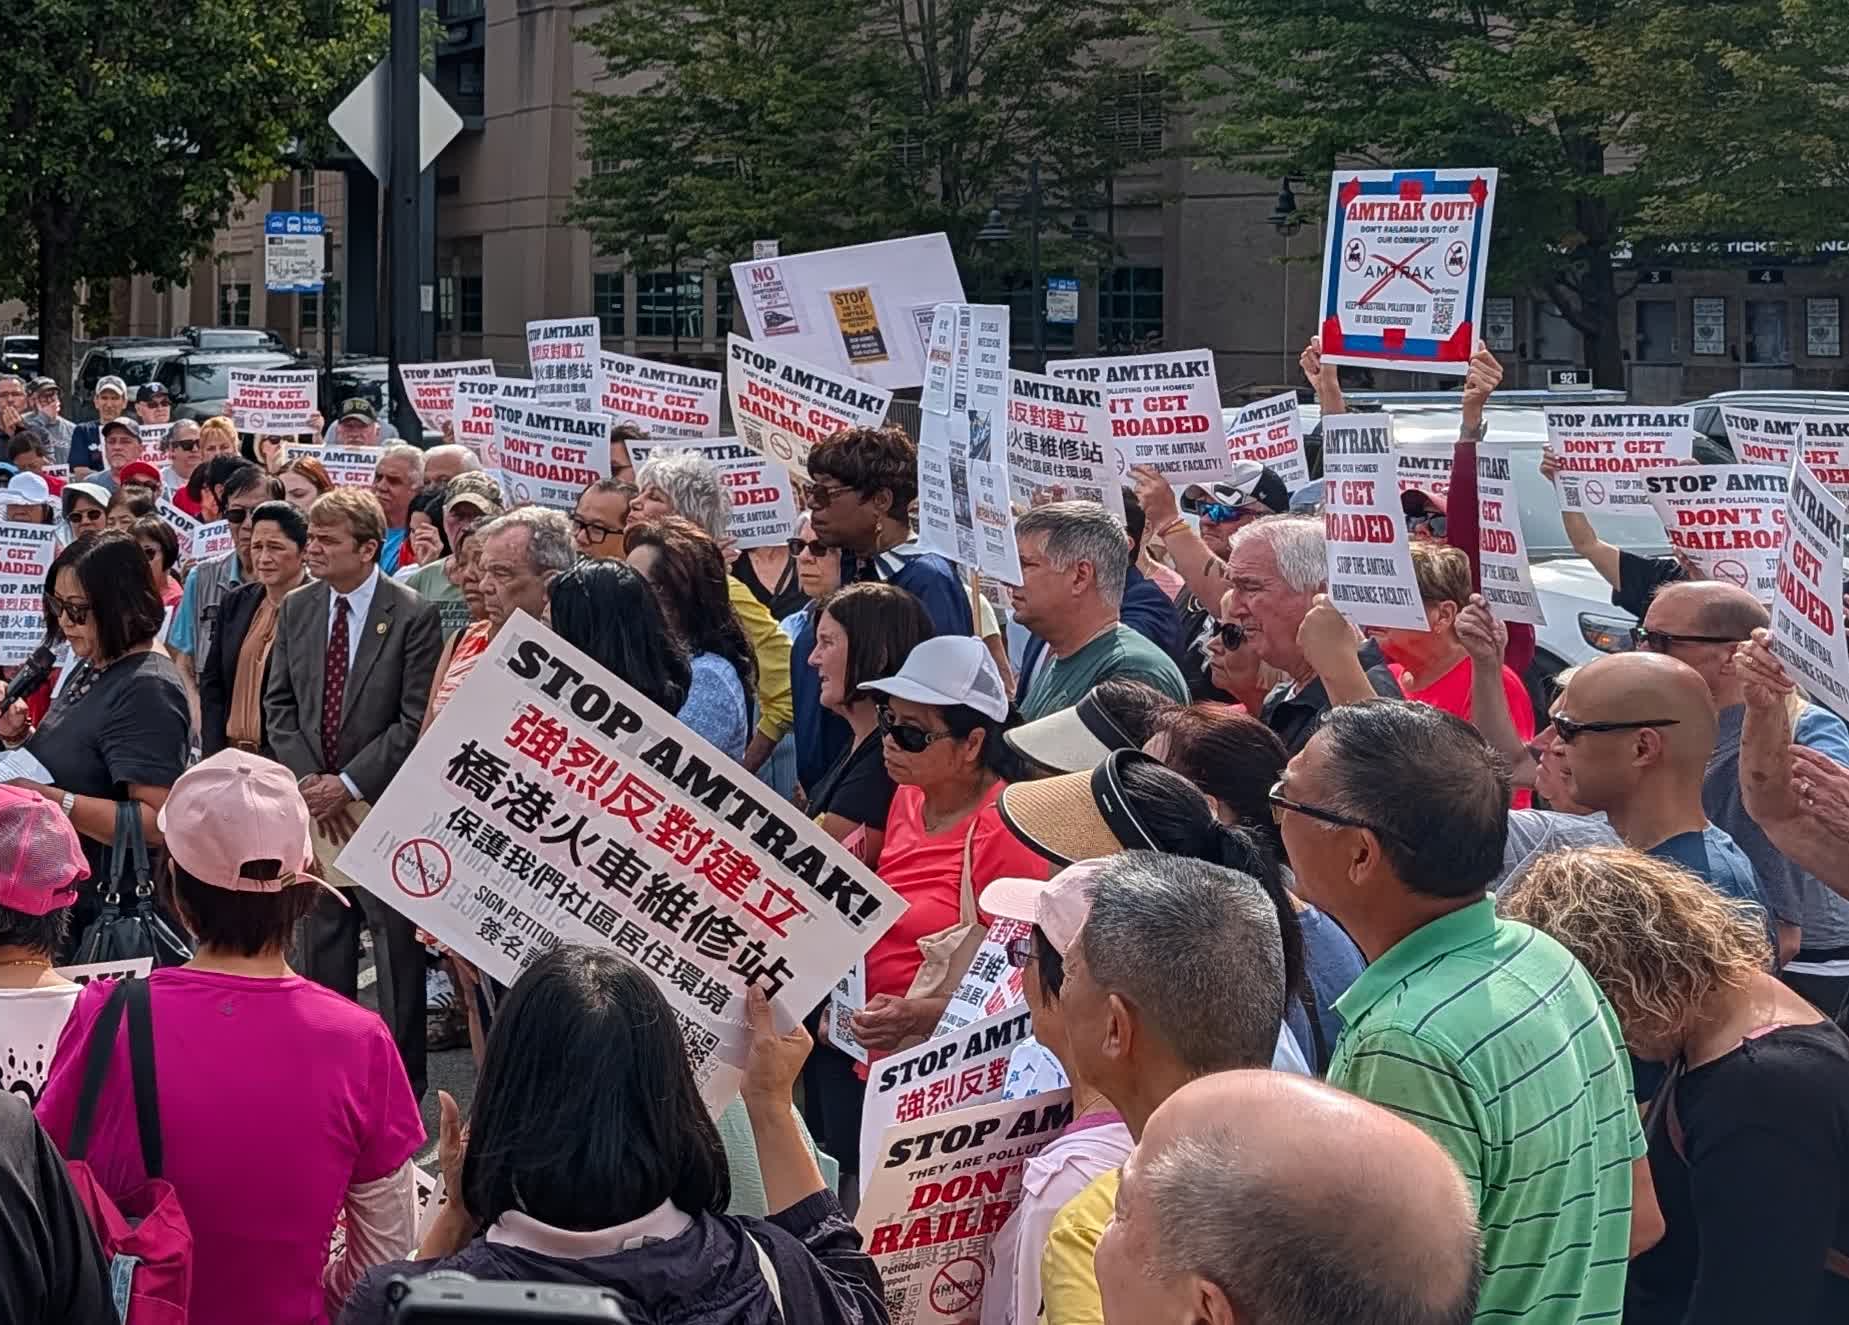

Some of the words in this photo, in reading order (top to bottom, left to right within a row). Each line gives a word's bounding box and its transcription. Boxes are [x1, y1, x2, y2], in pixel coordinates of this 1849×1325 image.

[1347, 201, 1427, 222] AMTRAK
[1430, 200, 1475, 221] OUT!
[1360, 225, 1382, 233] DON'T
[1383, 225, 1418, 233] RAILROAD
[752, 266, 775, 282] NO
[1364, 265, 1435, 280] AMTRAK
[1651, 271, 1660, 283] 3
[1761, 272, 1771, 282] 4
[834, 291, 866, 305] STOP
[543, 324, 594, 339] AMTRAK!
[231, 372, 256, 381] STOP
[258, 374, 315, 383] AMTRAK!
[403, 367, 430, 379] STOP
[431, 365, 492, 378] AMTRAK!
[600, 357, 635, 375] STOP
[639, 366, 718, 391] AMTRAK!
[731, 343, 776, 374] STOP
[780, 365, 885, 415] AMTRAK!
[1053, 367, 1101, 383] STOP
[1106, 360, 1210, 383] AMTRAK!
[1560, 372, 1577, 385] 921
[239, 389, 274, 399] DON'T
[278, 391, 303, 399] GET
[458, 381, 498, 396] STOP
[609, 382, 658, 403] DON'T
[663, 394, 698, 409] GET
[1013, 379, 1101, 407] AMTRAK!
[1163, 383, 1195, 392] HOMES!
[233, 398, 311, 410] RAILROADED
[601, 395, 709, 426] RAILROADED
[747, 380, 801, 416] DON'T
[808, 409, 848, 432] GET
[812, 398, 828, 409] OUR
[1143, 395, 1188, 413] GET
[1240, 399, 1296, 424] AMTRAK!
[494, 404, 523, 425] STOP
[525, 412, 606, 438] AMTRAK!
[1548, 414, 1585, 427] STOP
[1590, 414, 1689, 427] AMTRAK!
[1725, 414, 1759, 432] STOP
[1268, 425, 1289, 440] GET
[1325, 428, 1390, 455] AMTRAK!
[504, 435, 545, 457] DON'T
[551, 446, 587, 464] GET
[1135, 444, 1151, 457] STOP
[1153, 444, 1169, 456] THE
[1171, 441, 1206, 455] AMTRAK
[1564, 440, 1616, 453] DON'T
[1624, 441, 1666, 453] GET
[1743, 443, 1788, 462] DON'T
[500, 452, 601, 486] RAILROADED
[1183, 460, 1222, 472] FACILITY!
[1559, 457, 1679, 472] RAILROADED
[344, 473, 371, 482] GET
[720, 471, 761, 486] GET
[1647, 474, 1717, 493] STOP
[1341, 480, 1375, 506] GET
[1708, 497, 1767, 505] POLLUTING
[159, 505, 194, 532] STOP
[732, 513, 746, 524] THE
[747, 510, 777, 522] AMTRAK
[1482, 500, 1502, 523] GET
[1677, 508, 1762, 527] DON'T
[755, 522, 791, 536] FACILITY!
[7, 548, 36, 561] GET
[1792, 539, 1823, 587] GET
[1337, 555, 1352, 574] STOP
[1354, 556, 1366, 575] THE
[1368, 557, 1397, 577] AMTRAK
[1332, 583, 1377, 603] MAINTENANCE
[1378, 587, 1413, 607] FACILITY!
[1791, 618, 1803, 645] THE
[1804, 627, 1834, 668] AMTRAK
[508, 641, 642, 748] STOP
[639, 735, 881, 926] AMTRAK!
[504, 704, 810, 939] 強烈反對建立
[446, 739, 796, 1000] 橋港火車維修站
[444, 805, 733, 1015] 保護我們社區居住環境
[474, 885, 505, 915] SIGN
[506, 905, 562, 949] PETITION
[879, 1042, 957, 1093] STOP
[884, 1118, 1001, 1169] STOP
[908, 1164, 948, 1181] THEY
[952, 1156, 982, 1171] ARE
[880, 1261, 921, 1276] Petition
